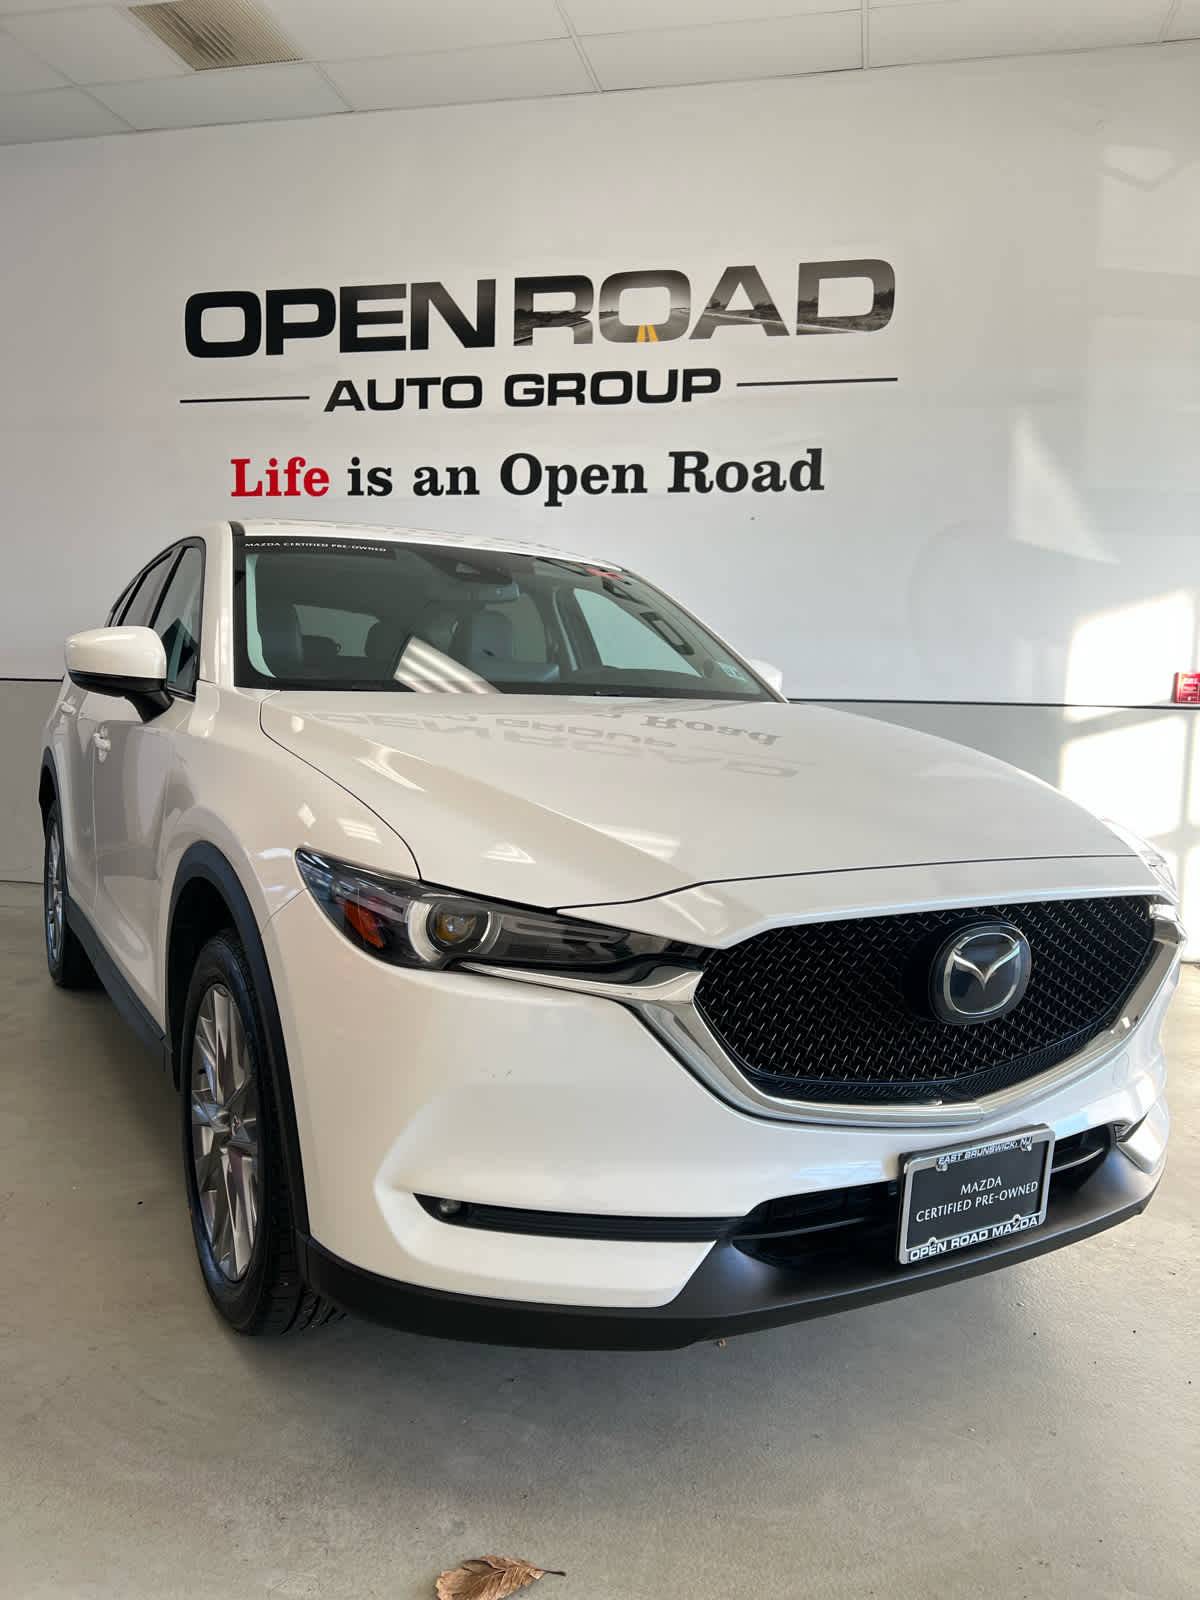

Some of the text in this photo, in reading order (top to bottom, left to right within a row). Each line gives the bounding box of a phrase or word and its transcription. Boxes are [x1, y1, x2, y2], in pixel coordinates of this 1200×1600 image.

[185, 258, 896, 358] OPEN ROAD
[324, 368, 722, 412] AUTO GROUP
[230, 448, 825, 507] Life is an Open Road
[938, 1153, 963, 1165] EAST
[1020, 1136, 1033, 1147] NJ
[916, 1181, 1038, 1223] CERTIFIED PRE-OWNED
[960, 1176, 1002, 1196] MAZDA
[910, 1216, 1038, 1261] OPEN ROAD MAZDA
